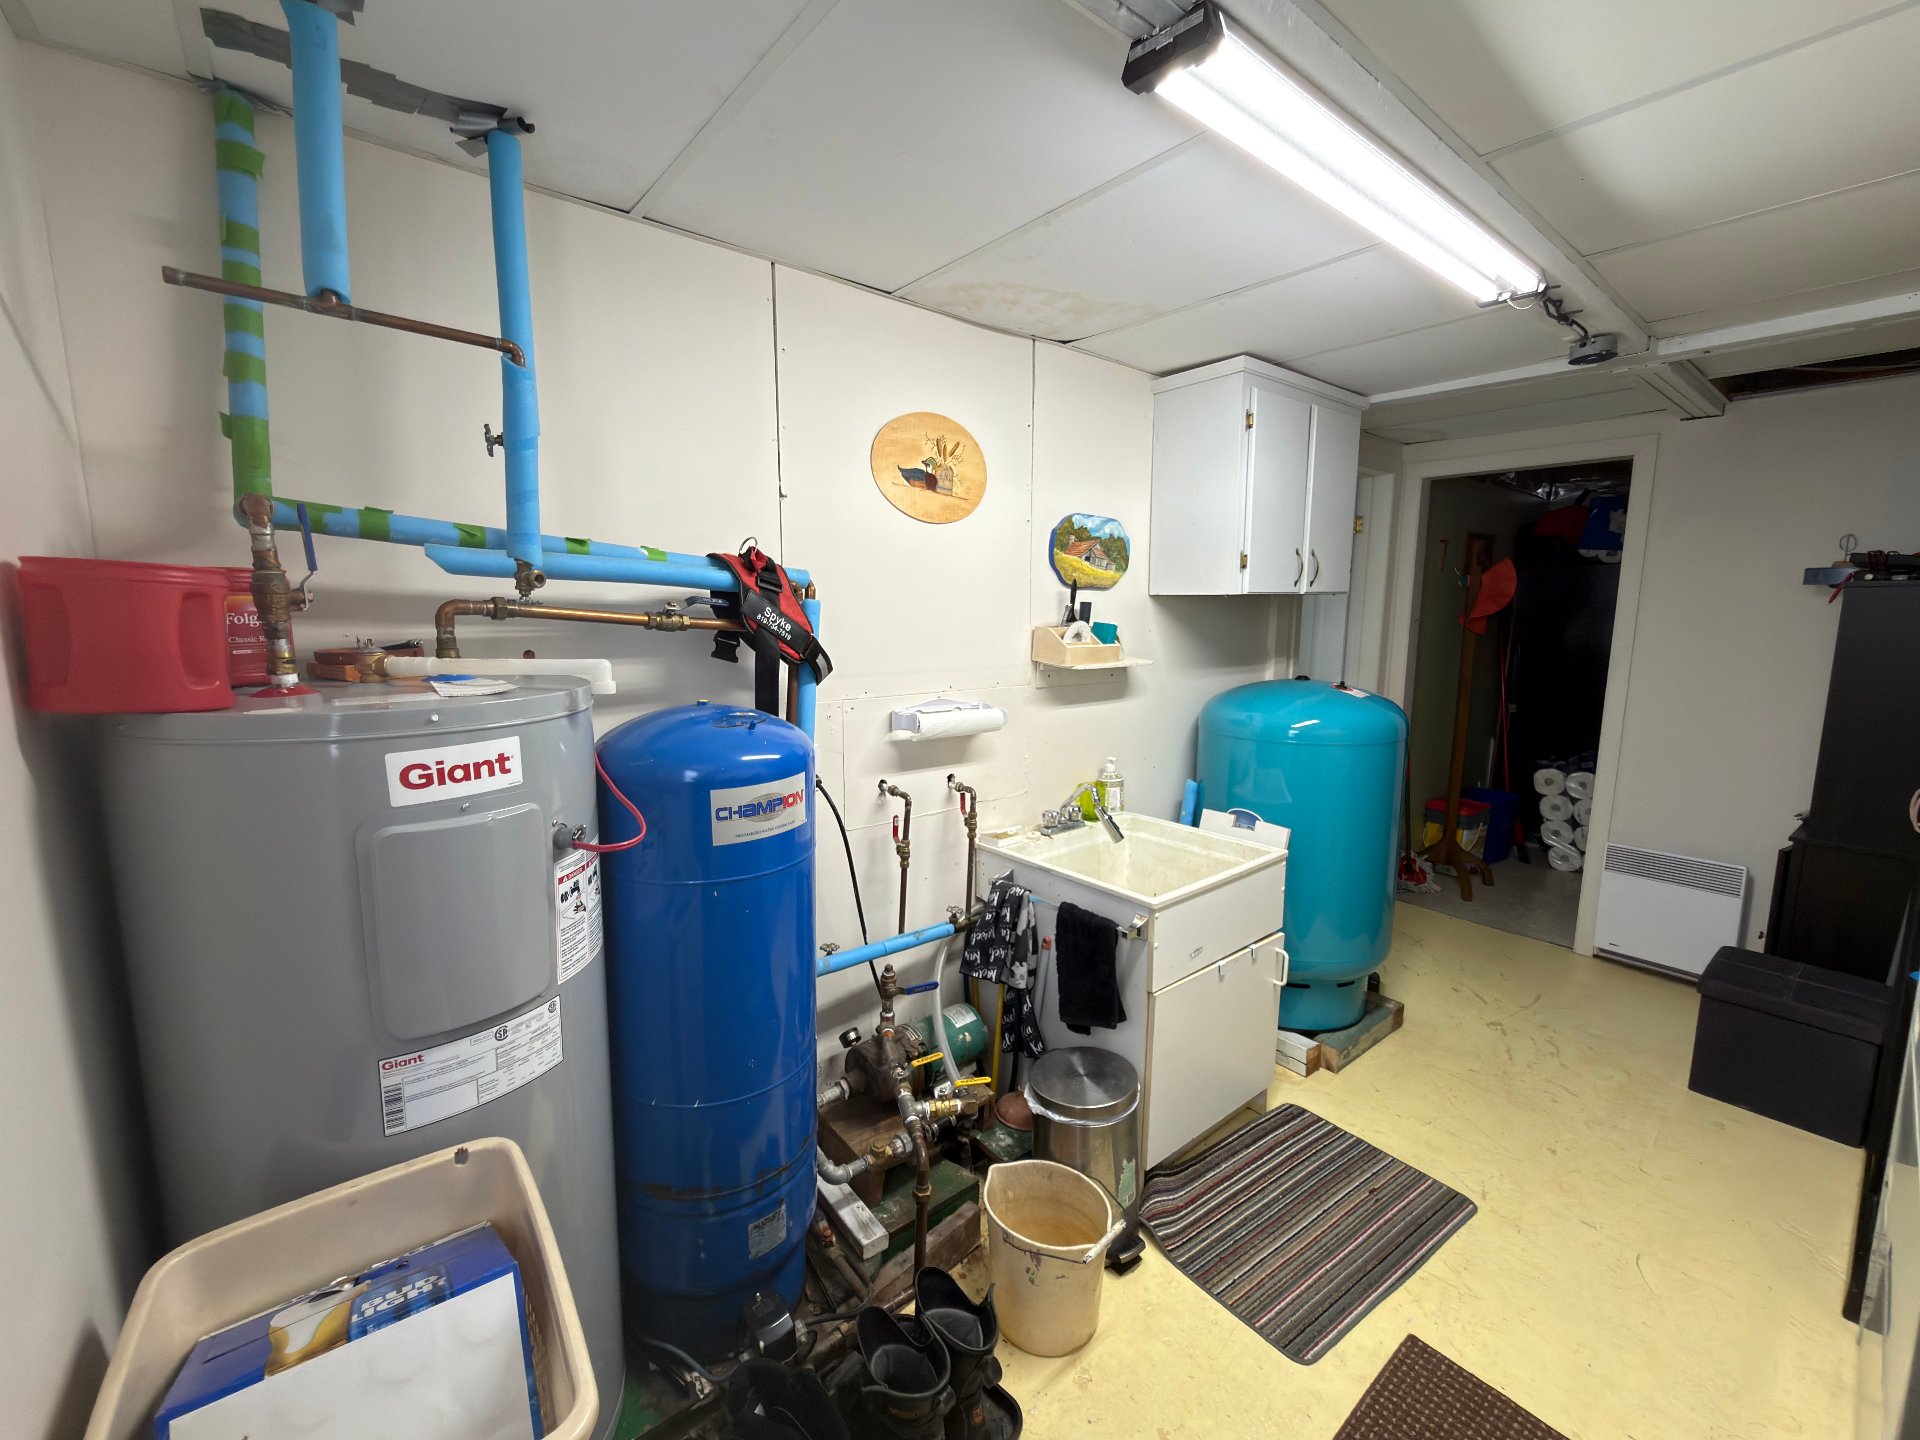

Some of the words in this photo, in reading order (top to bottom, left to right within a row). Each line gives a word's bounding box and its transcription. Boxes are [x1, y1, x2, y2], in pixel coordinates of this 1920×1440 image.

[226, 612, 262, 628] Folg
[764, 606, 792, 632] Spyke
[399, 752, 512, 791] Giant
[715, 789, 804, 822] CHAMPION
[381, 1053, 425, 1071] Giant
[360, 1274, 440, 1311] BUD
